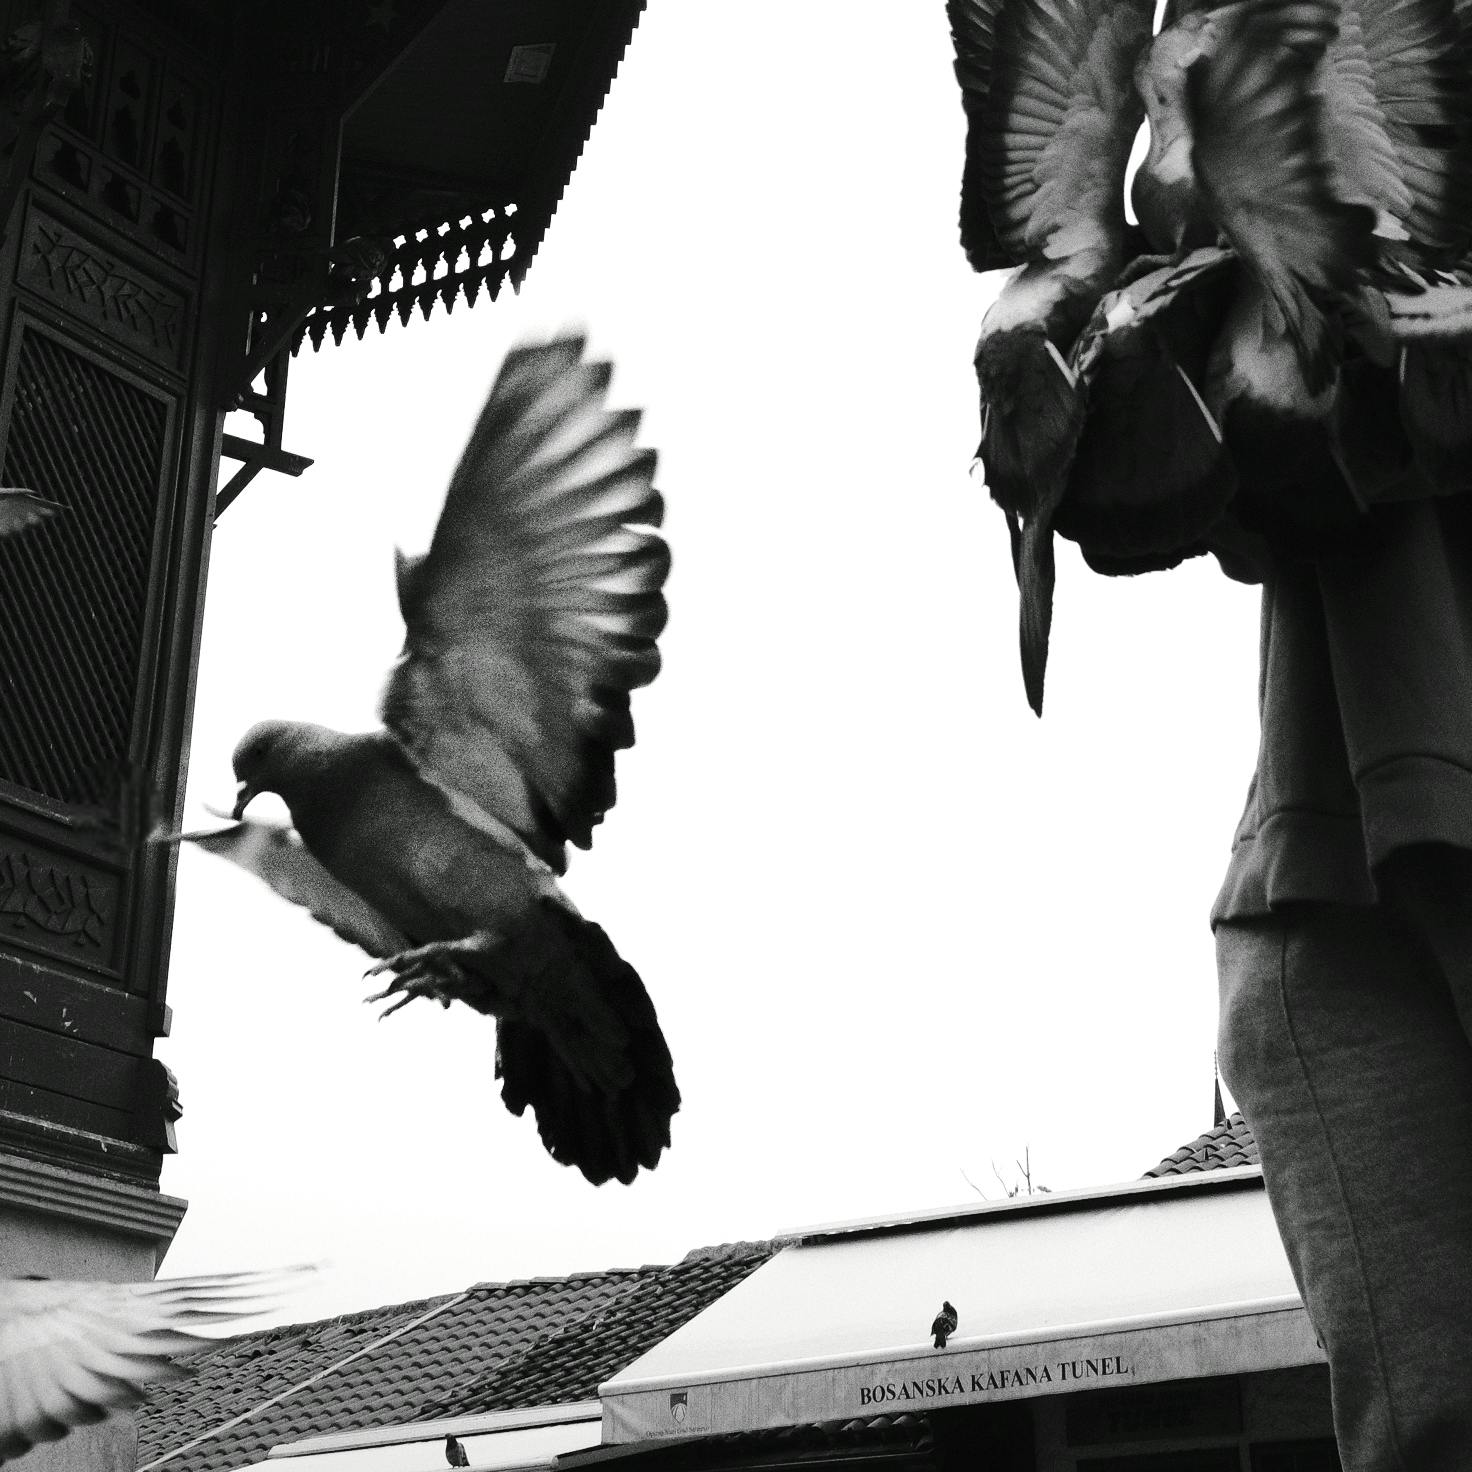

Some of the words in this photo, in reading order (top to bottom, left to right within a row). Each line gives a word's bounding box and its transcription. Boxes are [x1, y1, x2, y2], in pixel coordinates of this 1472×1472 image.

[860, 1376, 965, 1406] BOSANSKA
[970, 1364, 1053, 1393] KAFANA
[1057, 1356, 1129, 1381] TUNEL
